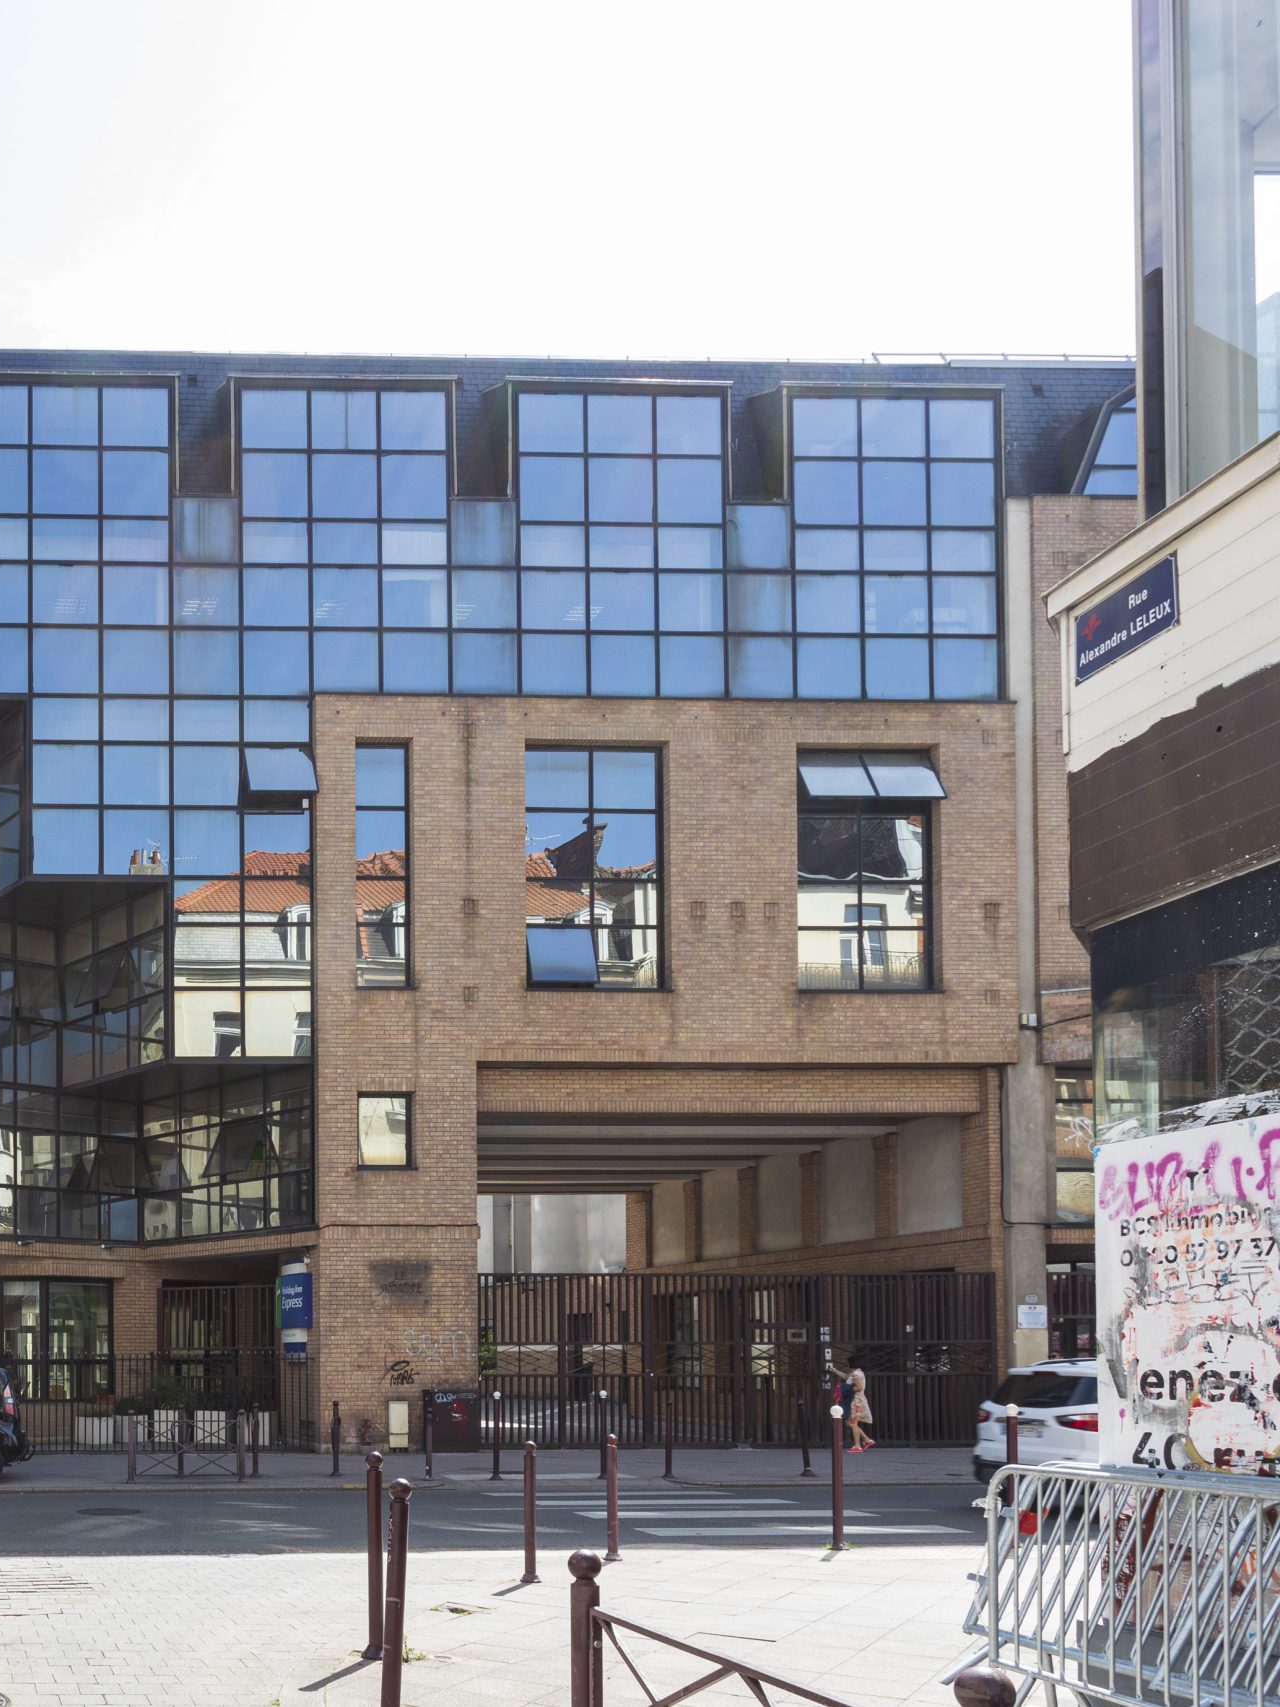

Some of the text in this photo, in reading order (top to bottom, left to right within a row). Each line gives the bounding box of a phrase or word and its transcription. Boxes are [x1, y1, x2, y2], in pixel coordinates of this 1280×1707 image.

[1128, 589, 1148, 609] Rue
[1079, 599, 1172, 667] Alexandre LELEUX
[1216, 1239, 1243, 1260] 97
[1250, 1236, 1276, 1257] 37
[281, 1285, 303, 1296] Holiday Inn
[281, 1297, 303, 1311] Express
